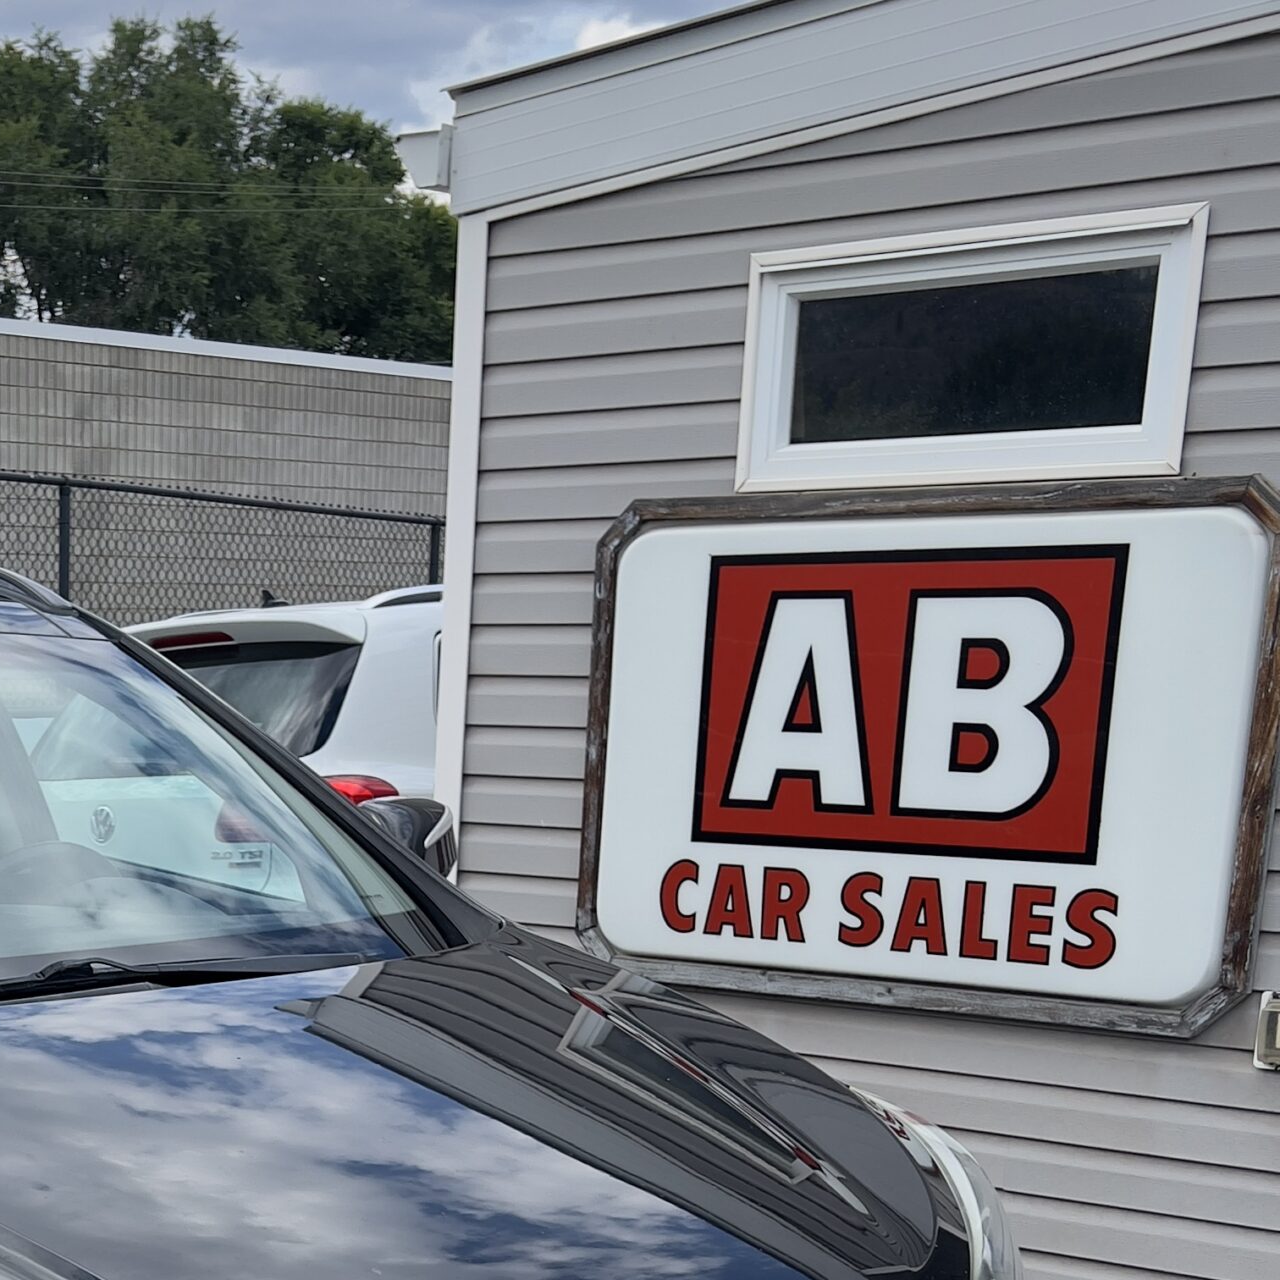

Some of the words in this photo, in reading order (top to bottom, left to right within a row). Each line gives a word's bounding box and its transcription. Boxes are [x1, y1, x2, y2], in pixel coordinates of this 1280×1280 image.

[720, 587, 1075, 822] AB
[660, 858, 810, 943] CAR
[838, 871, 1120, 971] SALES
